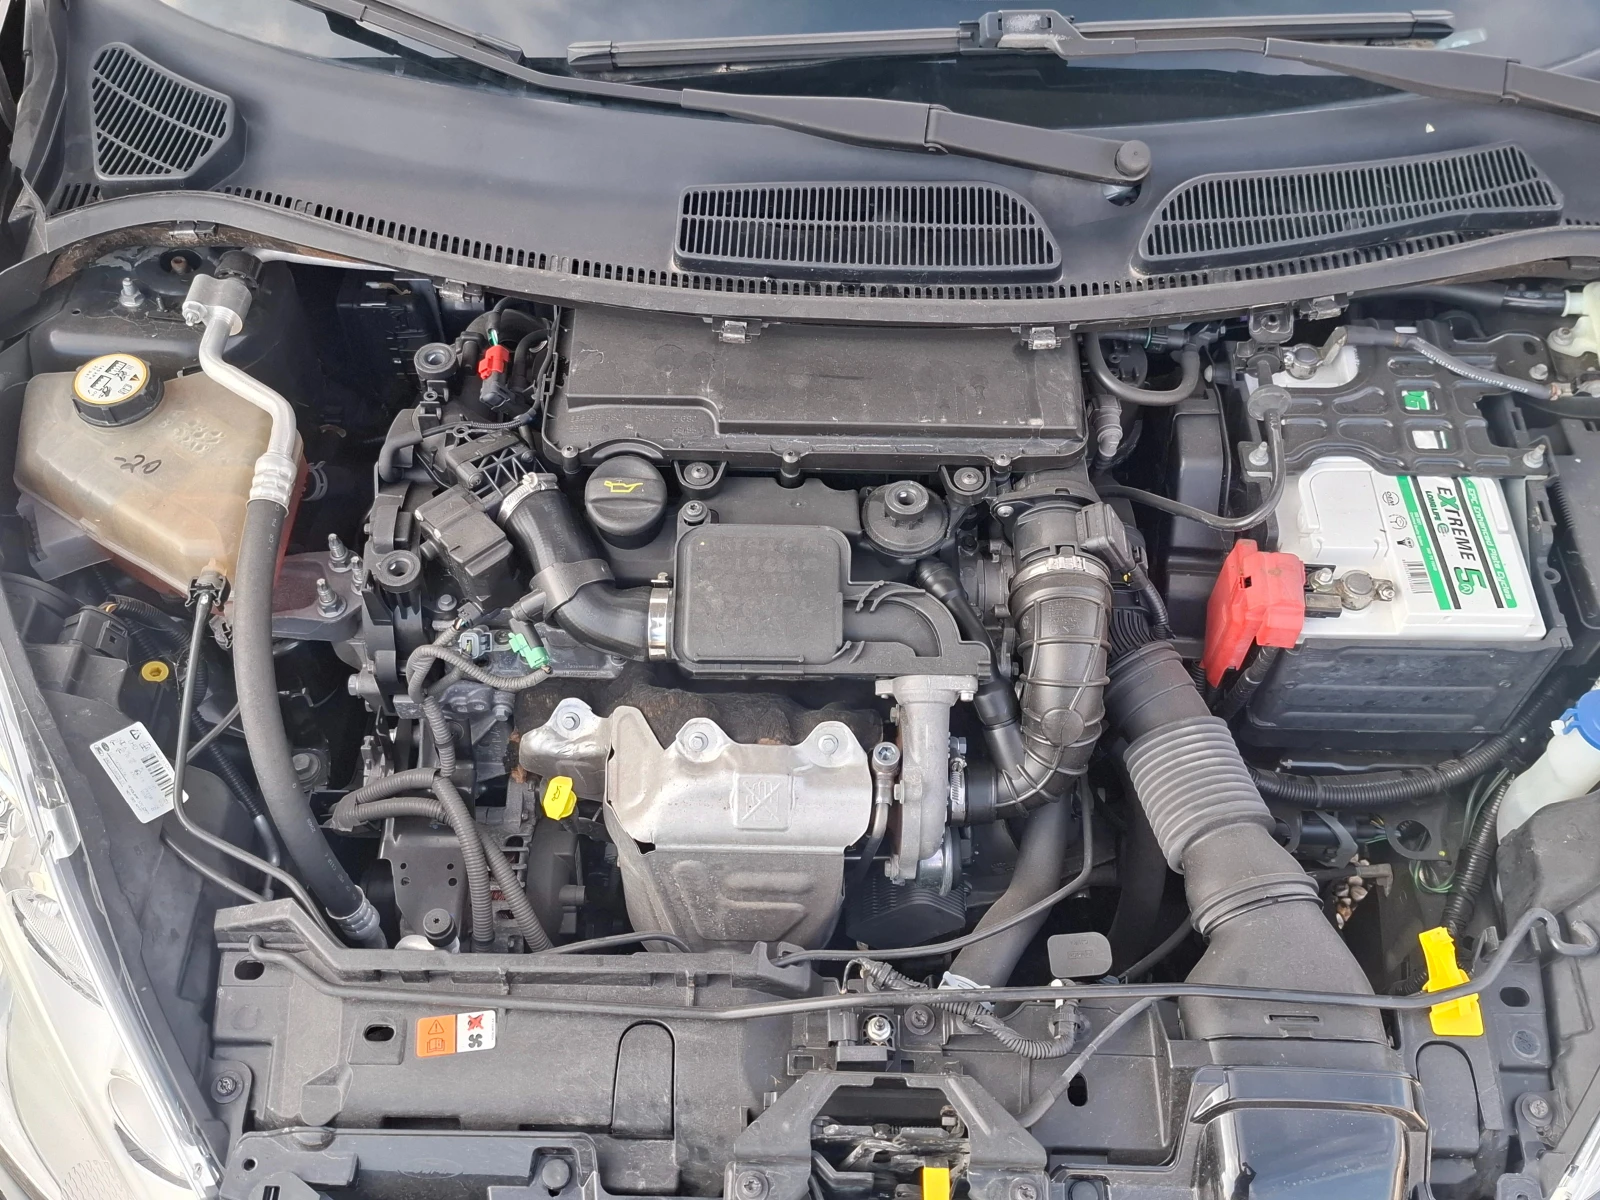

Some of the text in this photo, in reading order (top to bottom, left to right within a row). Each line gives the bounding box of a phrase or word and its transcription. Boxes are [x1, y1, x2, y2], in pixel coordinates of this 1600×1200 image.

[1437, 486, 1477, 562] EXTREME
[1467, 487, 1513, 600] EPC Enhanced Plate Cycles
